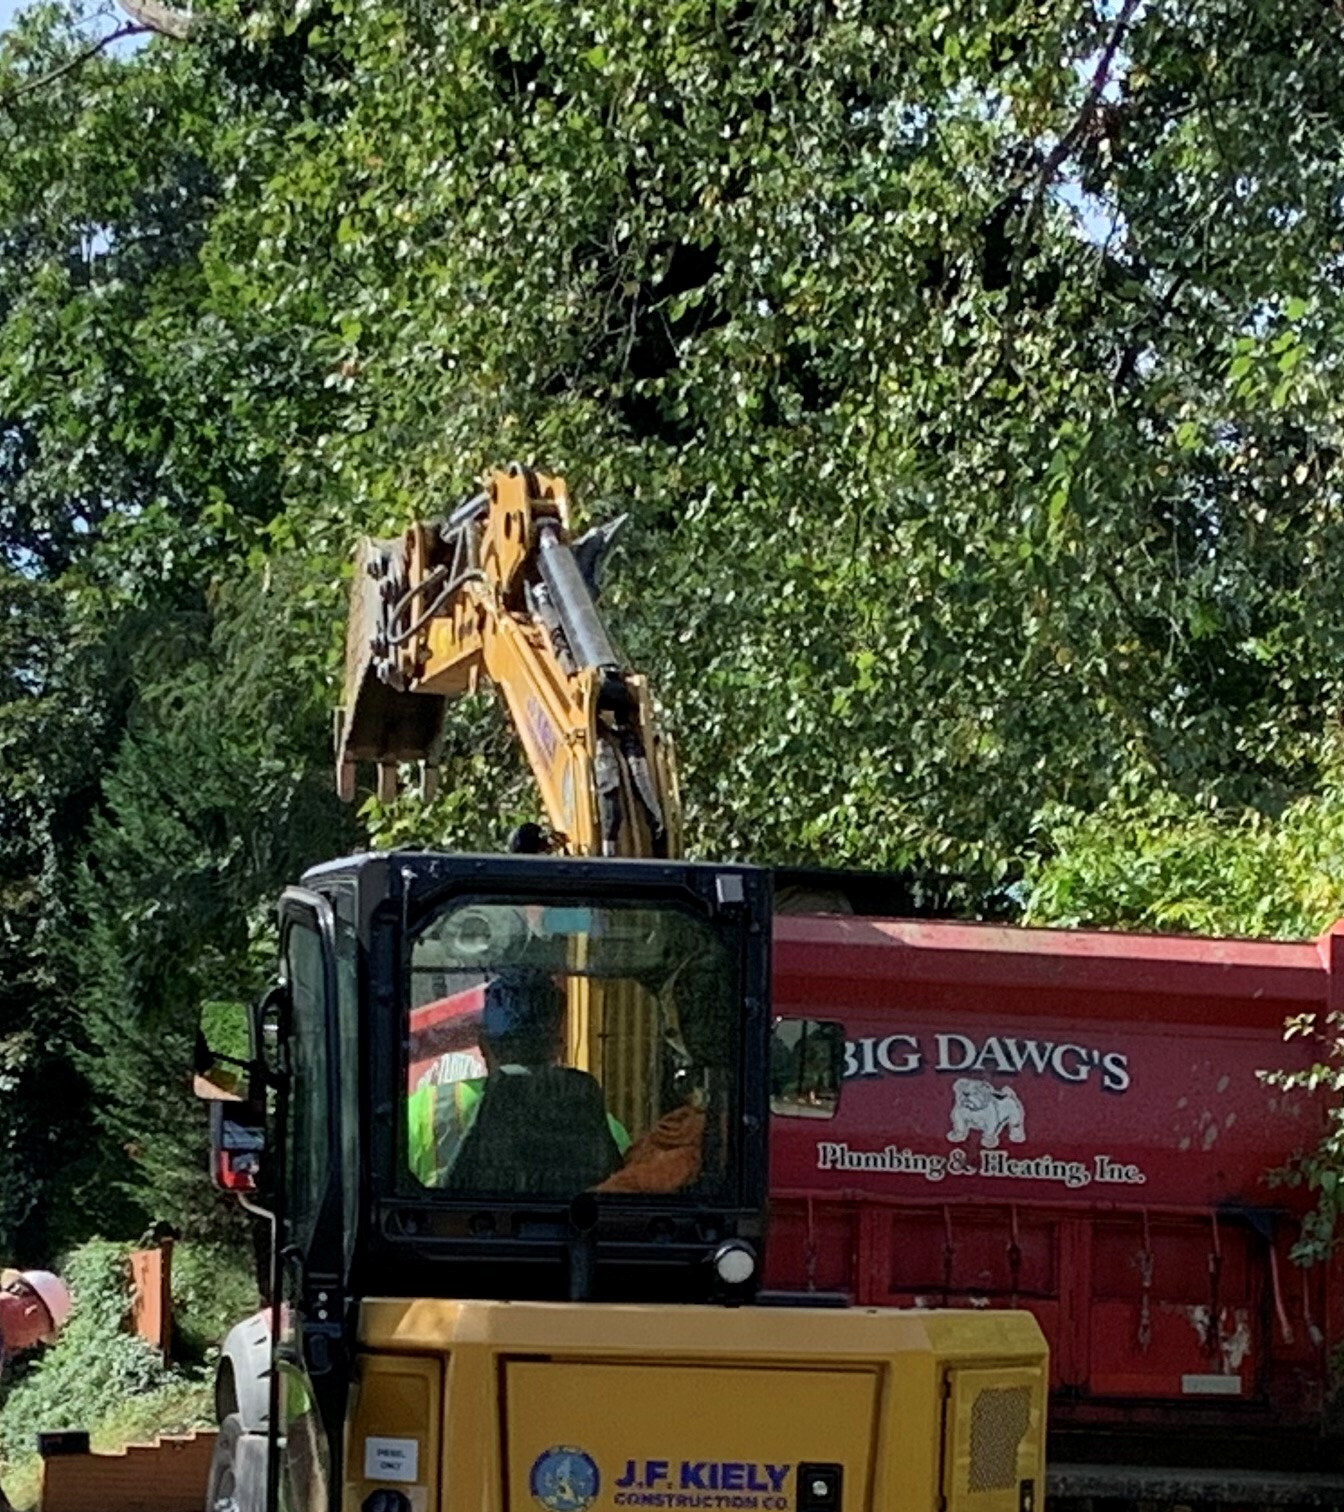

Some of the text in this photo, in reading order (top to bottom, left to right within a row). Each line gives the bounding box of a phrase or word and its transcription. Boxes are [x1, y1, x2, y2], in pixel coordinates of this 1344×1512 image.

[934, 1034, 1131, 1091] DAWG'S
[817, 1141, 1147, 1188] Plumbing & Heating, Inc.
[680, 1461, 791, 1492] KIELY
[614, 1492, 757, 1509] CONSTRUCTION
